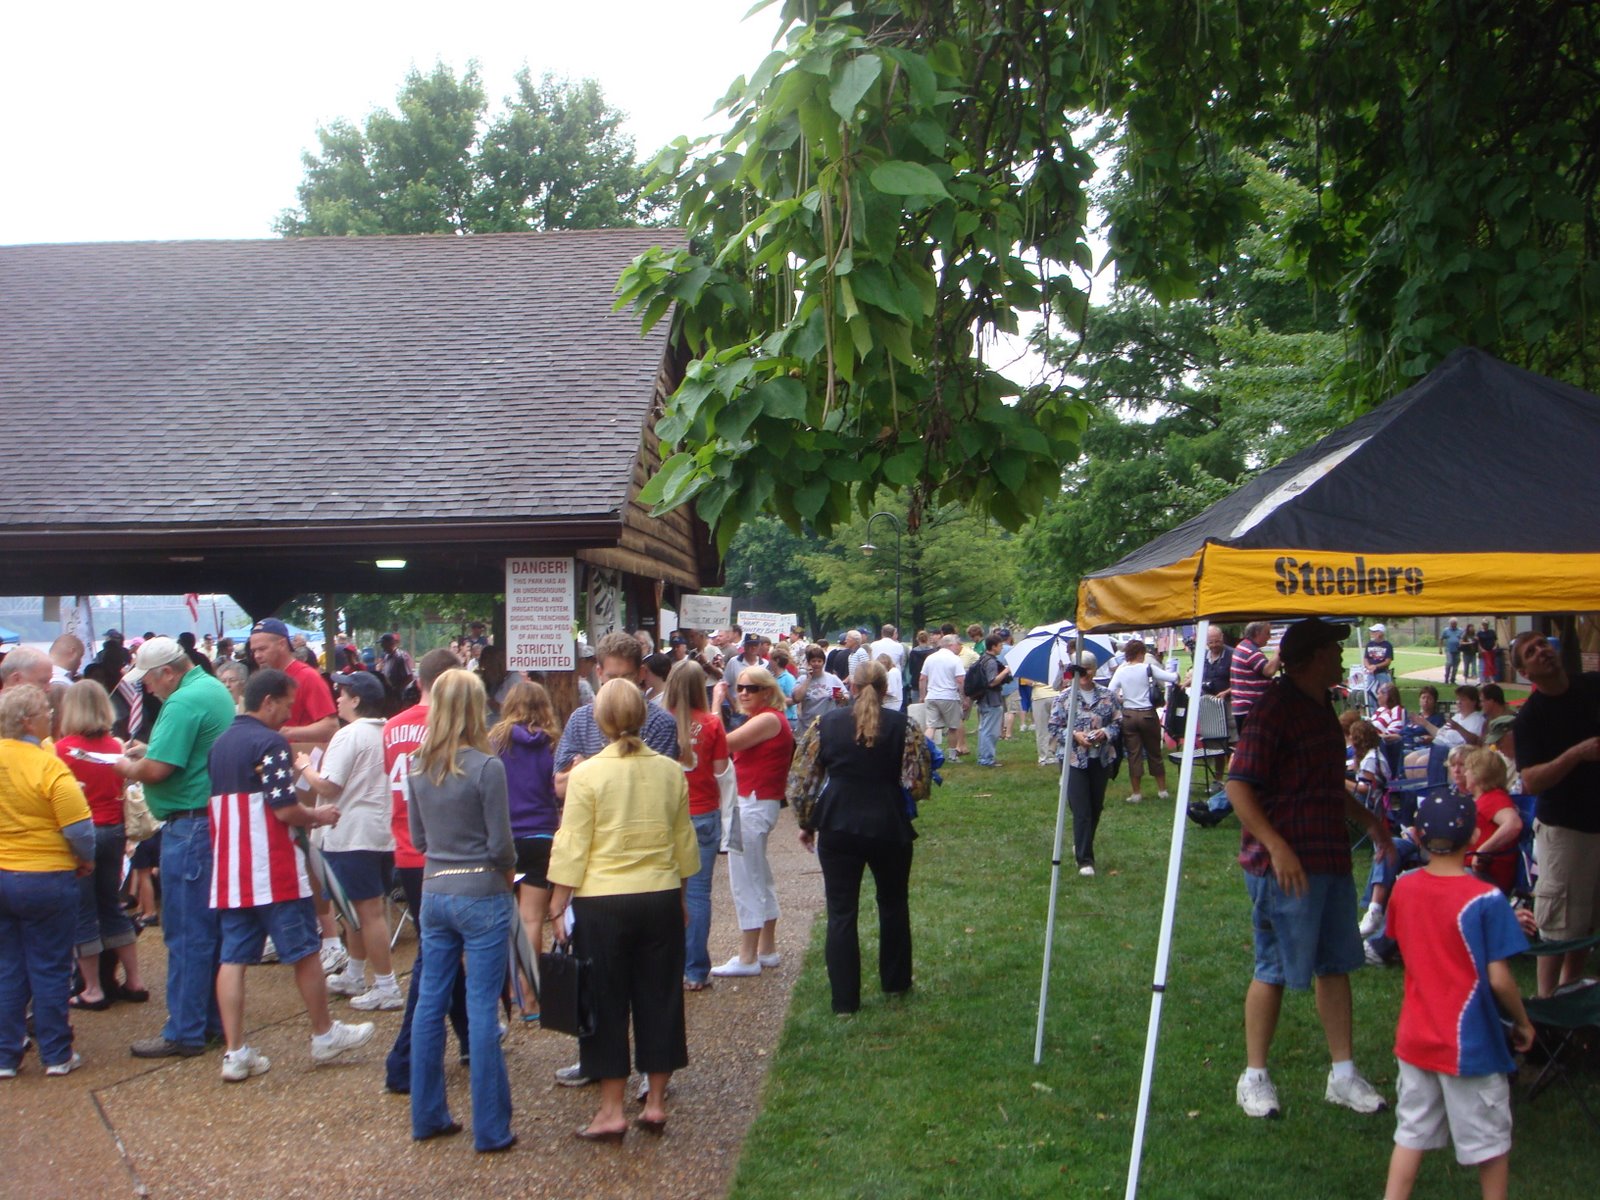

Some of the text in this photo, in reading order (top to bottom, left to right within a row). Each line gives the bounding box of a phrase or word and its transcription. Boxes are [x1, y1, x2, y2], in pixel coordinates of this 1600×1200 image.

[512, 561, 568, 574] DANGER!
[1274, 556, 1425, 596] Steelers
[516, 644, 564, 655] STRICTLY
[510, 656, 571, 667] PROHIBITED
